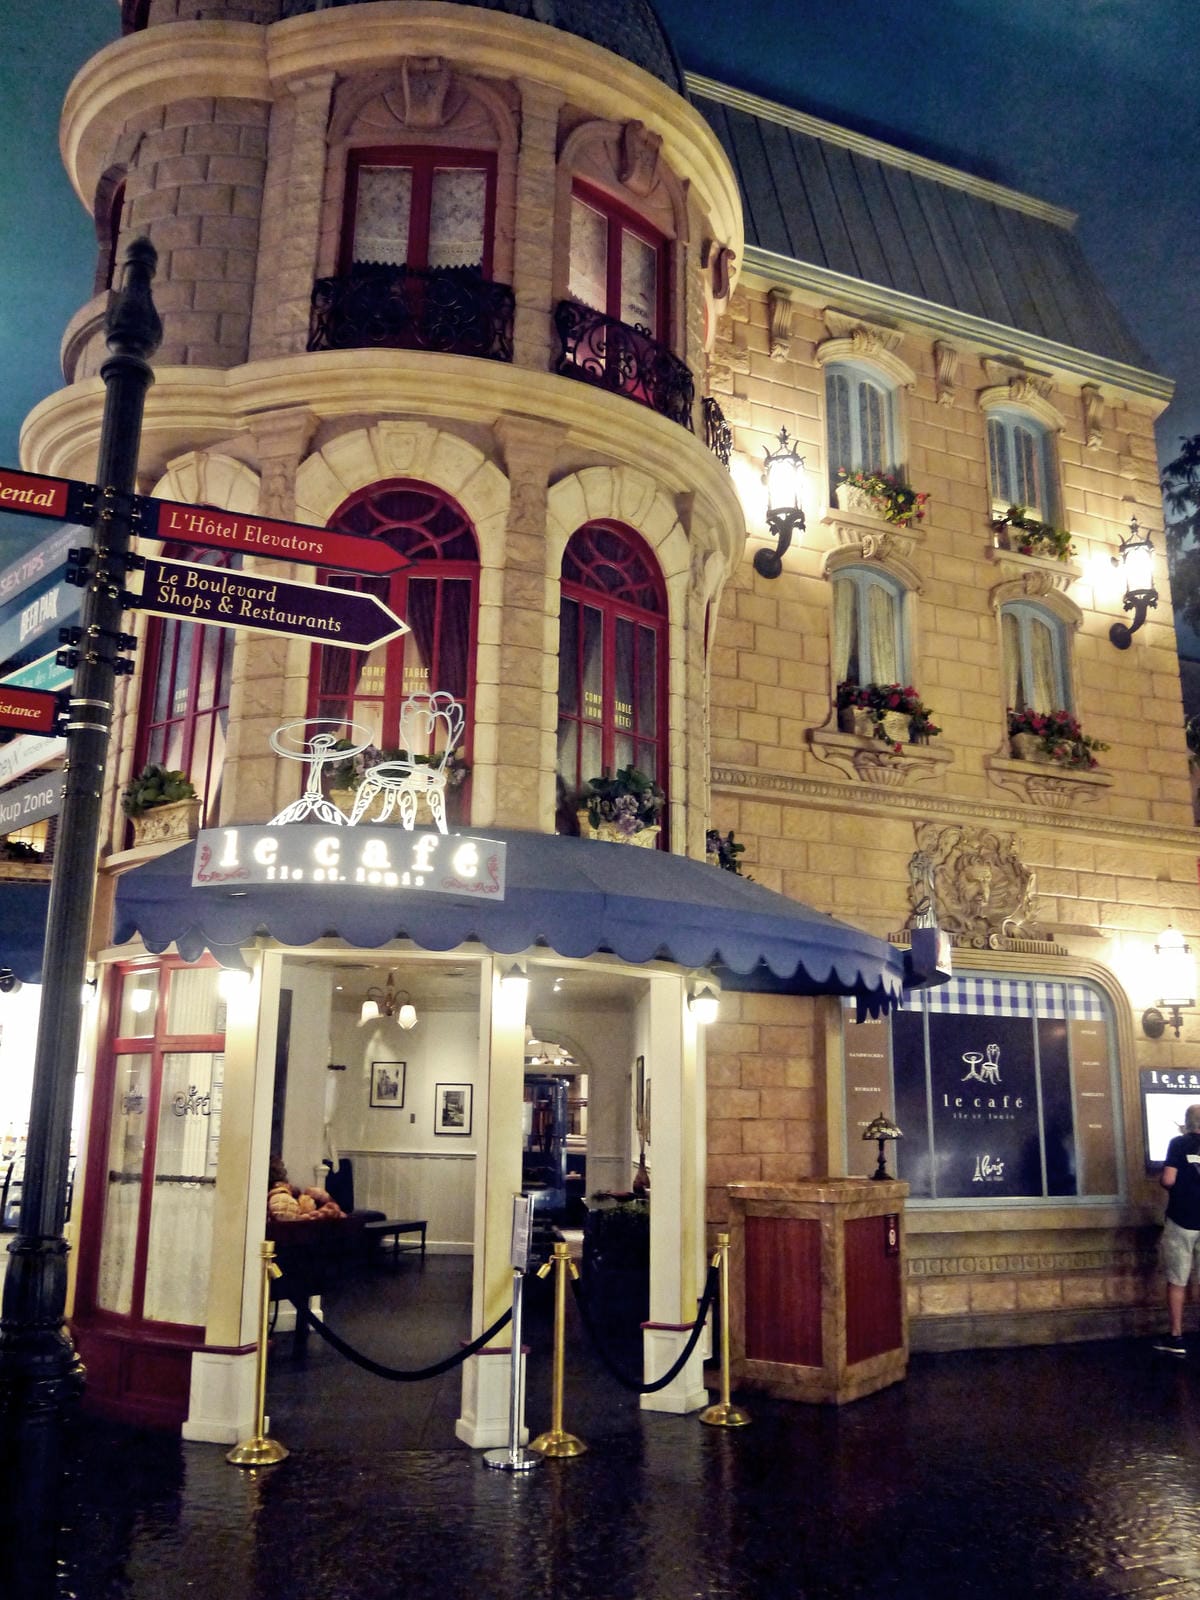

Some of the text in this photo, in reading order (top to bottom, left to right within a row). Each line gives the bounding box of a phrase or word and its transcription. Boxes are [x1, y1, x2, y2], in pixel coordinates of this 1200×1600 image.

[0, 482, 56, 507] ental
[169, 512, 324, 554] L'Hôtel Elevators
[157, 566, 278, 602] Le Boulevard
[157, 586, 342, 632] Shops & Restaurants
[24, 789, 54, 814] Zone
[219, 829, 280, 868] le
[355, 867, 425, 887] louis
[1151, 1070, 1169, 1084] le
[944, 1093, 963, 1108] le
